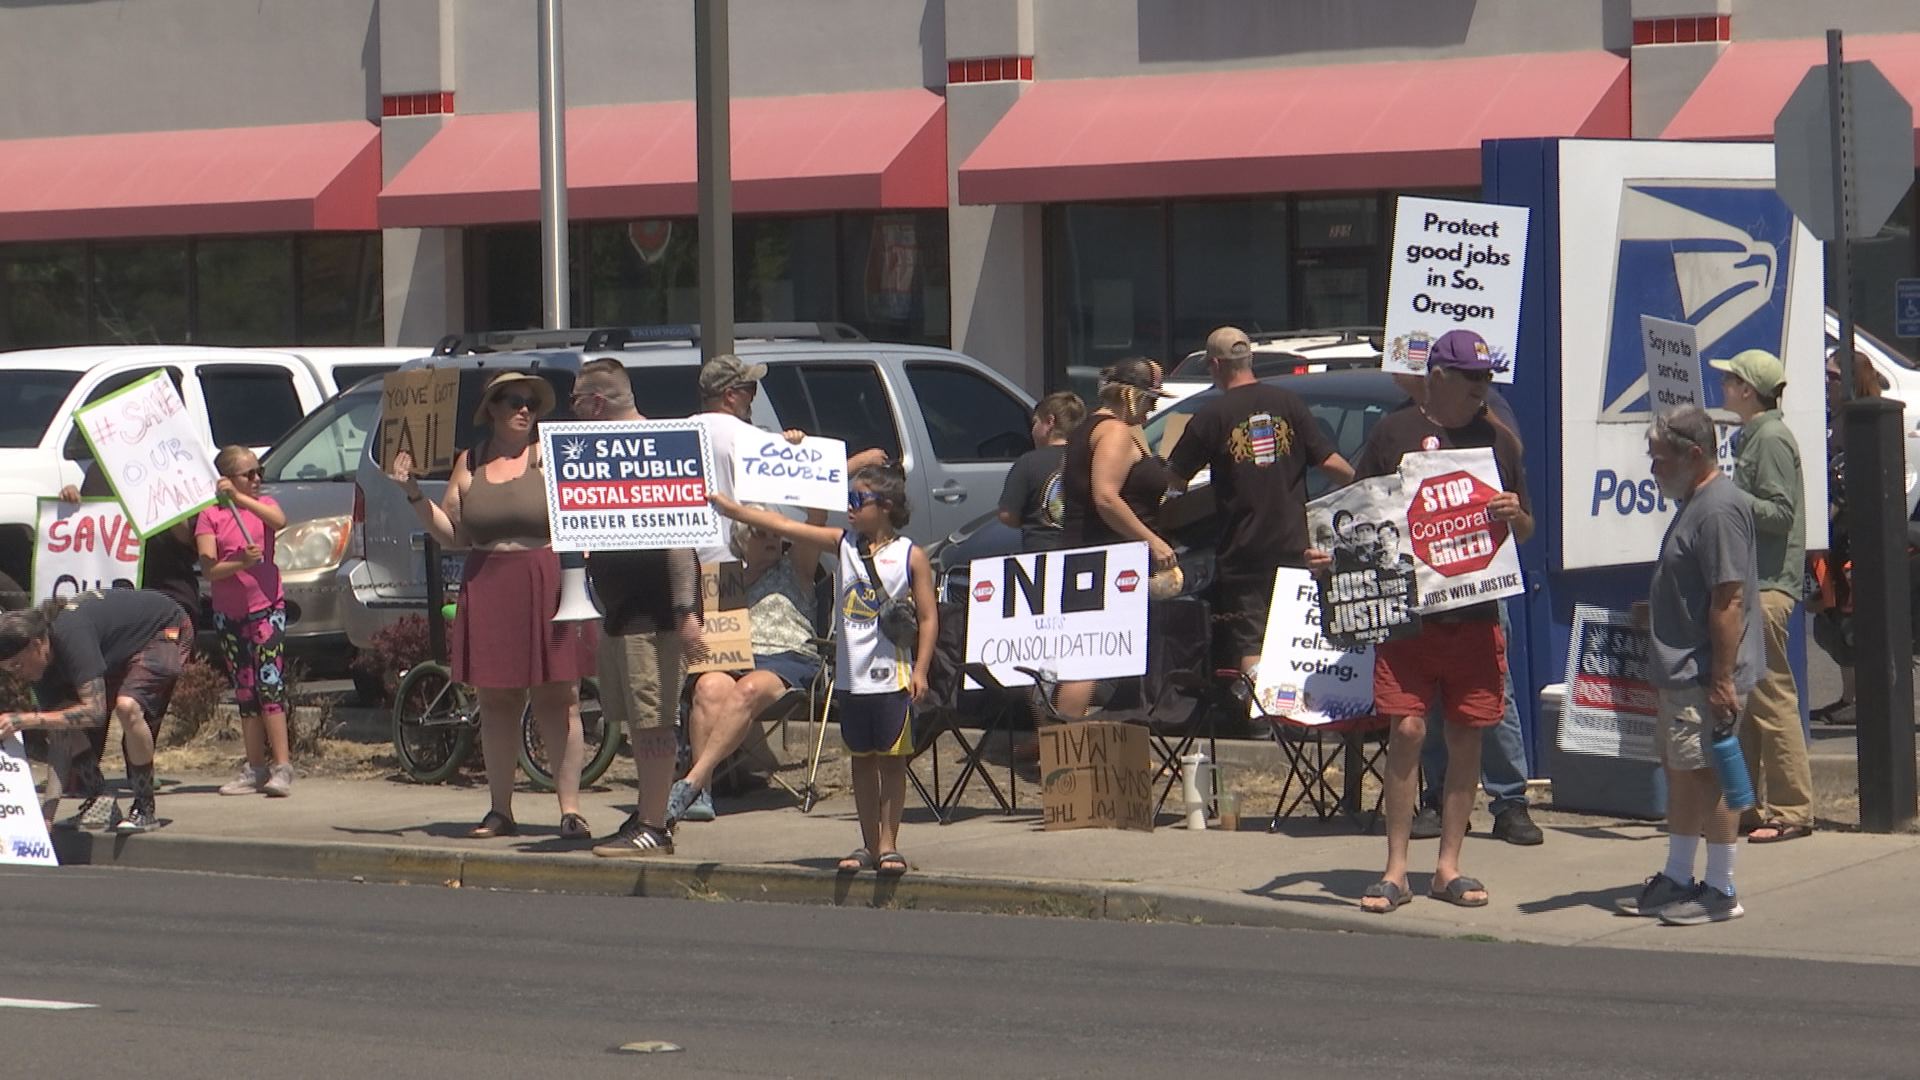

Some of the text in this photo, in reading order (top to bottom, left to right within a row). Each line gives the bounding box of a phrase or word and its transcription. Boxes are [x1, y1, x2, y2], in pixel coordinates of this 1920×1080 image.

[1424, 211, 1499, 238] Protect
[1407, 242, 1511, 268] good jobs
[1427, 267, 1485, 291] in So.
[1412, 293, 1494, 322] Oregon
[1648, 328, 1692, 357] Say no to
[1658, 361, 1689, 383] service
[434, 382, 457, 405] GOT
[383, 413, 451, 472] FAIL
[595, 438, 657, 458] SAVE
[760, 442, 823, 463] GOOD
[123, 437, 193, 487] OUR
[562, 458, 698, 481] OUR PUBLIC
[742, 457, 840, 483] TROUBLE
[562, 482, 704, 507] POSTAL SERVICE
[1421, 477, 1474, 512] STOP
[562, 511, 709, 530] FOREVER ESSENTIAL
[1412, 507, 1490, 540] Corporat
[48, 514, 141, 562] SAVE
[1428, 529, 1494, 566] GREED
[1003, 550, 1107, 618] NO
[1296, 584, 1320, 608] Fig
[1326, 569, 1379, 604] JOBS
[1423, 572, 1519, 606] JOBS WITH JUSTICE
[1305, 608, 1322, 625] fo
[1329, 596, 1412, 635] JUSTICE
[704, 650, 751, 665] MAIL
[981, 630, 1132, 666] CONSOLIDATION
[1290, 658, 1359, 682] voting.
[1041, 726, 1128, 766] IN MAIL
[1077, 764, 1149, 800] SNAIL
[1045, 803, 1076, 824] THE
[1088, 799, 1117, 821] PUT
